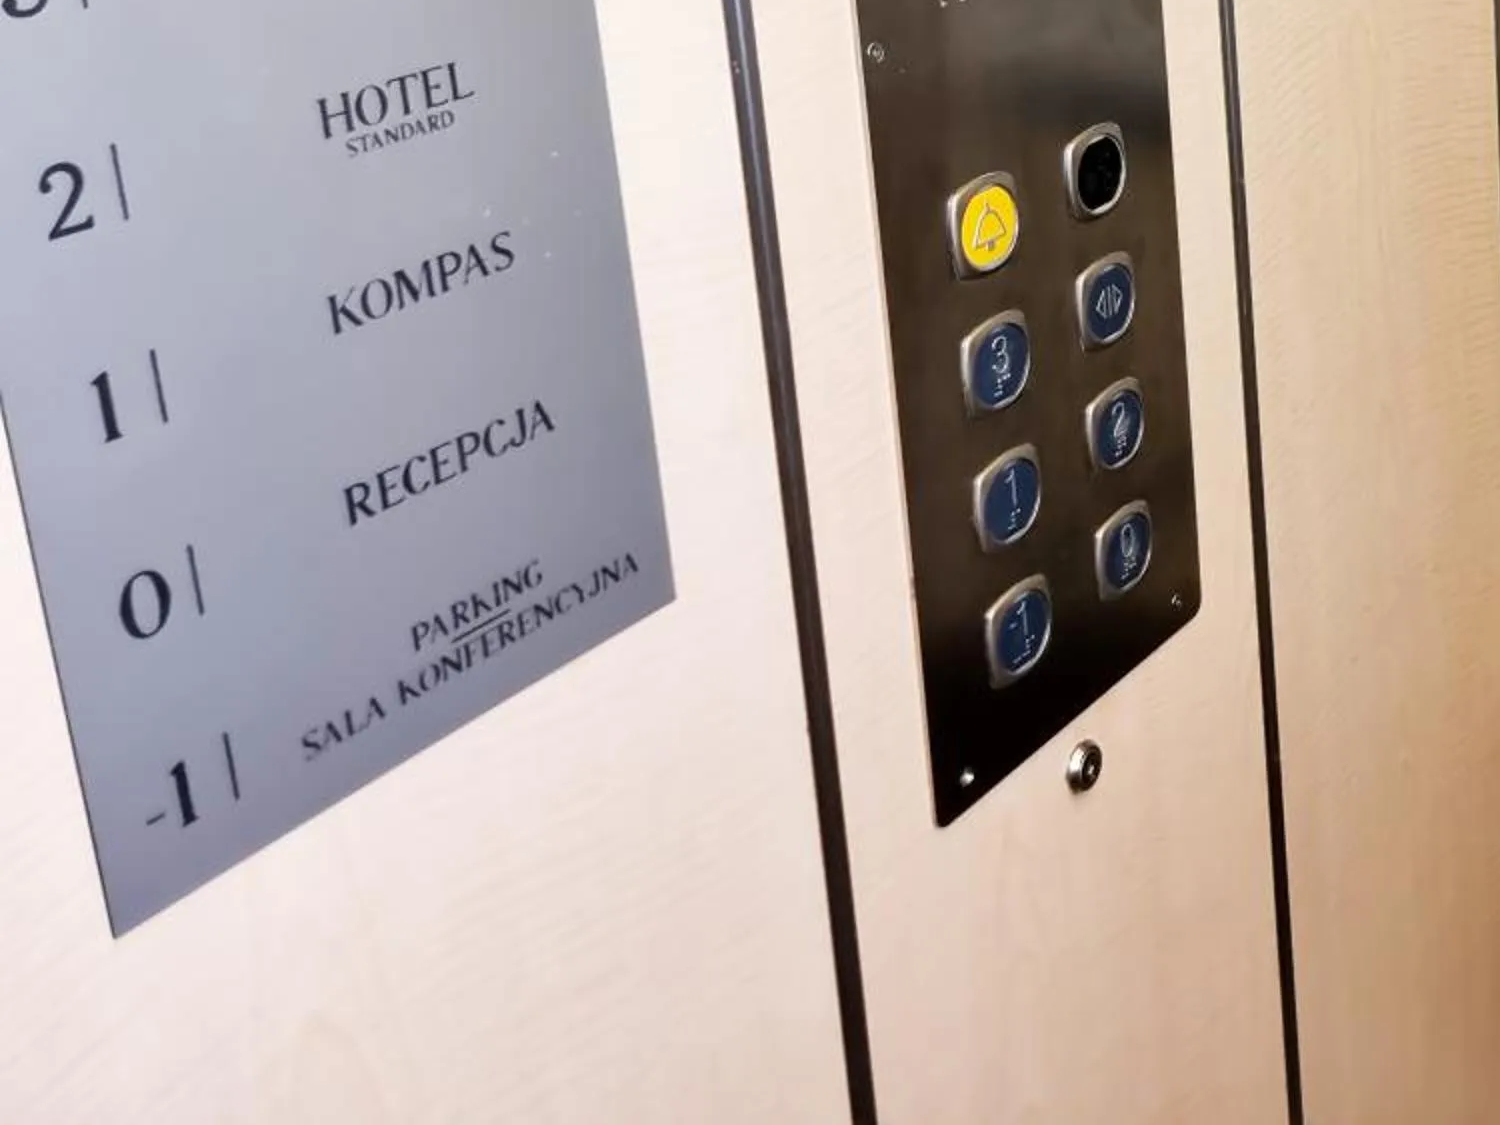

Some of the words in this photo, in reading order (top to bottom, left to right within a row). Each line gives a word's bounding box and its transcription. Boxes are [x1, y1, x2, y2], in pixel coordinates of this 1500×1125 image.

[317, 62, 475, 140] HOTEL
[345, 110, 456, 159] STANDARD
[38, 162, 95, 241] 2
[326, 231, 516, 336] KOMPAS
[991, 335, 1010, 374] 3
[90, 371, 124, 444] 1
[343, 399, 556, 527] RECEPCJA
[1004, 467, 1018, 507] 1
[119, 570, 172, 640] 0
[411, 559, 543, 652] PARKING
[301, 697, 387, 761] SALA
[396, 552, 639, 705] KONFERENCYJNA
[146, 760, 199, 828] -1
